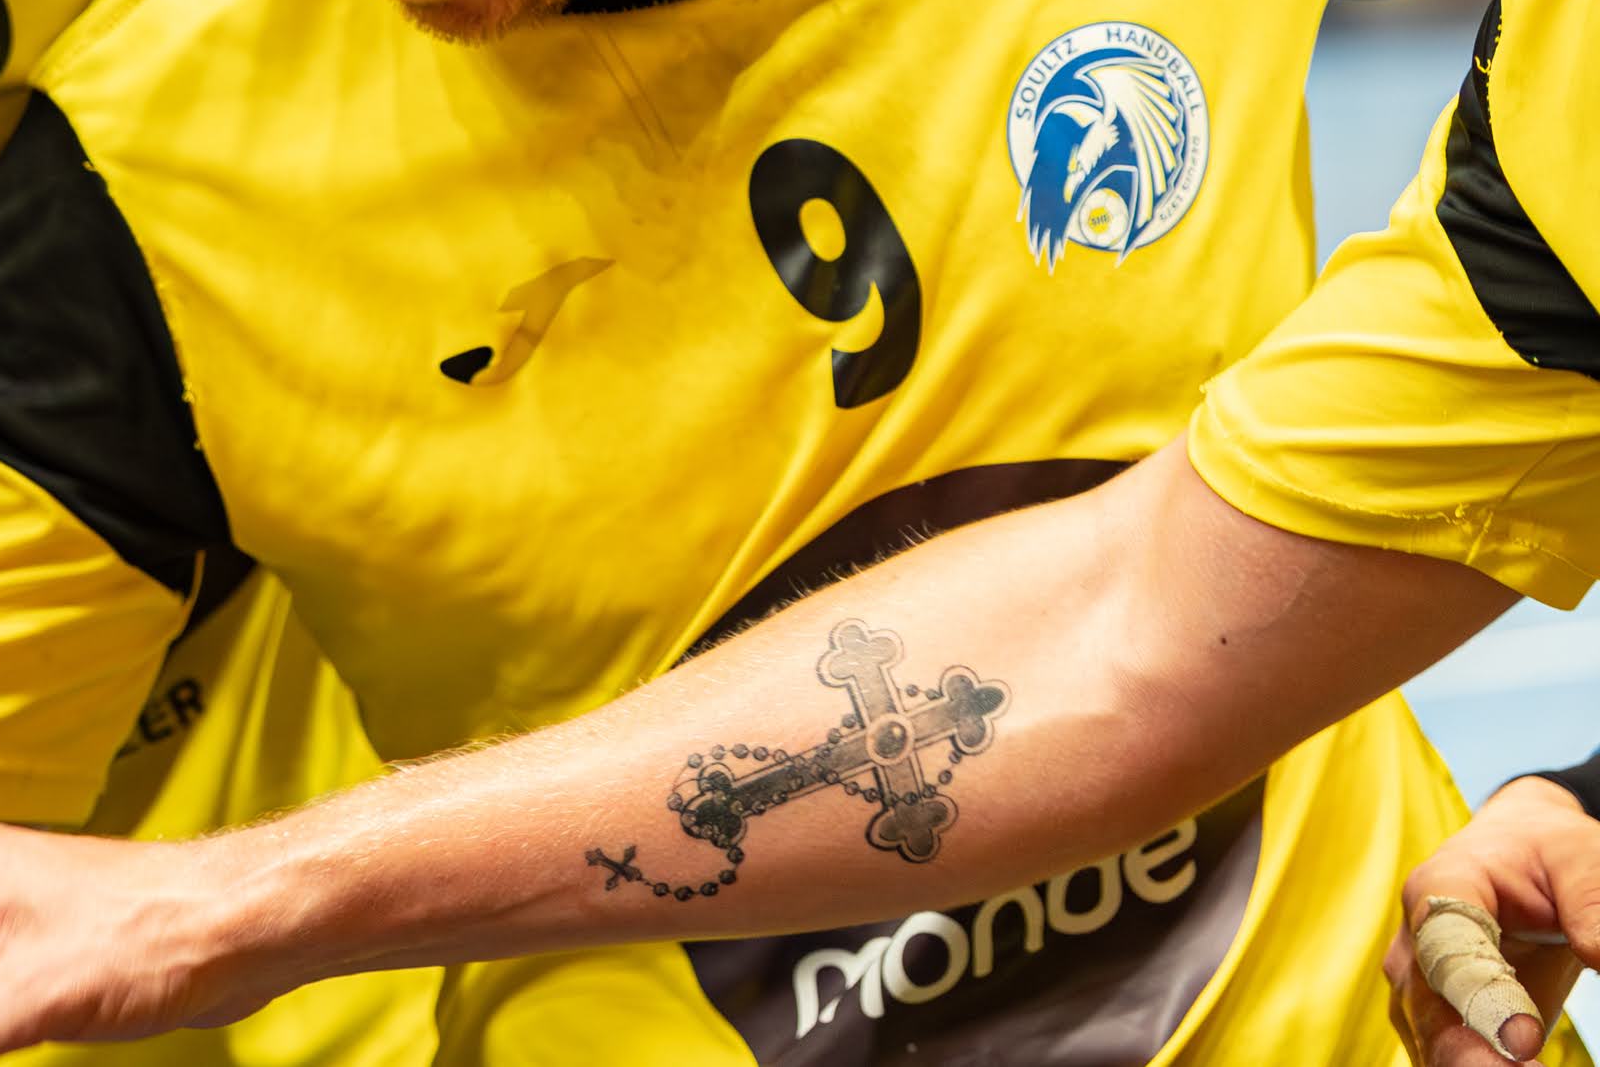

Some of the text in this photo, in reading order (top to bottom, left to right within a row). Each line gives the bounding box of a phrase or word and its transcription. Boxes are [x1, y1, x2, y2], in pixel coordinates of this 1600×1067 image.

[1016, 38, 1079, 121] SOULTZ
[1106, 27, 1203, 116] HANDBALL
[748, 138, 923, 410] 9
